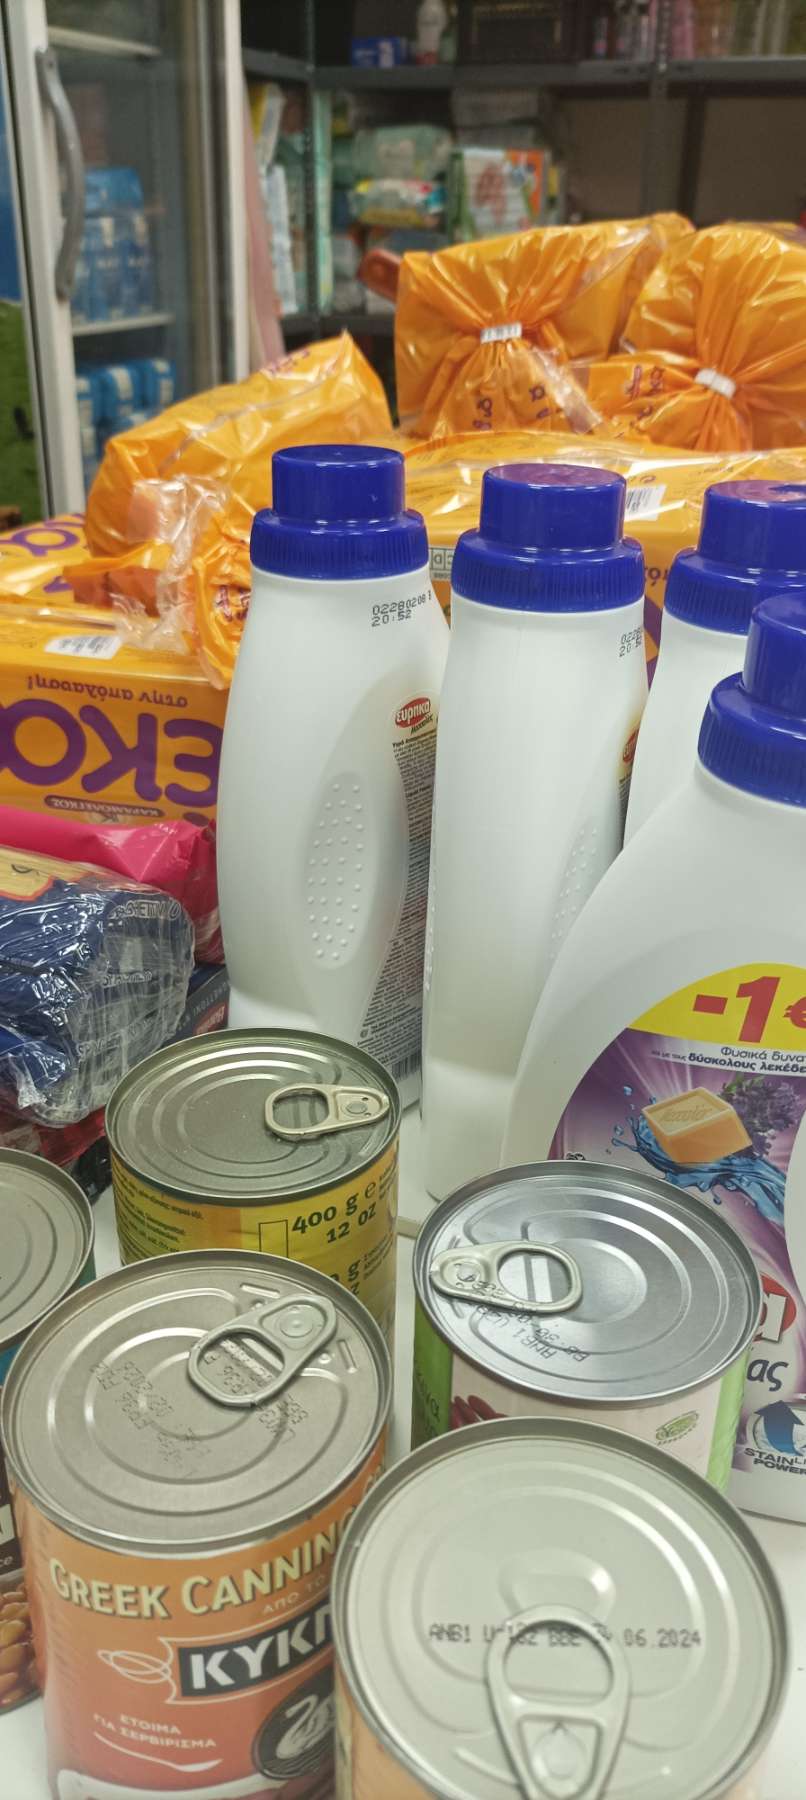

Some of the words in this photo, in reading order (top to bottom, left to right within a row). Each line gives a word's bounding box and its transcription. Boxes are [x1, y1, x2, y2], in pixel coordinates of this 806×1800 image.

[688, 1052, 756, 1071] δύσκολους
[721, 1046, 767, 1061] Φυσικά
[771, 1050, 806, 1063] δυνα
[291, 1206, 338, 1234] 400
[345, 1193, 358, 1217] g
[326, 1222, 350, 1243] 12
[49, 1556, 171, 1619] GREEK
